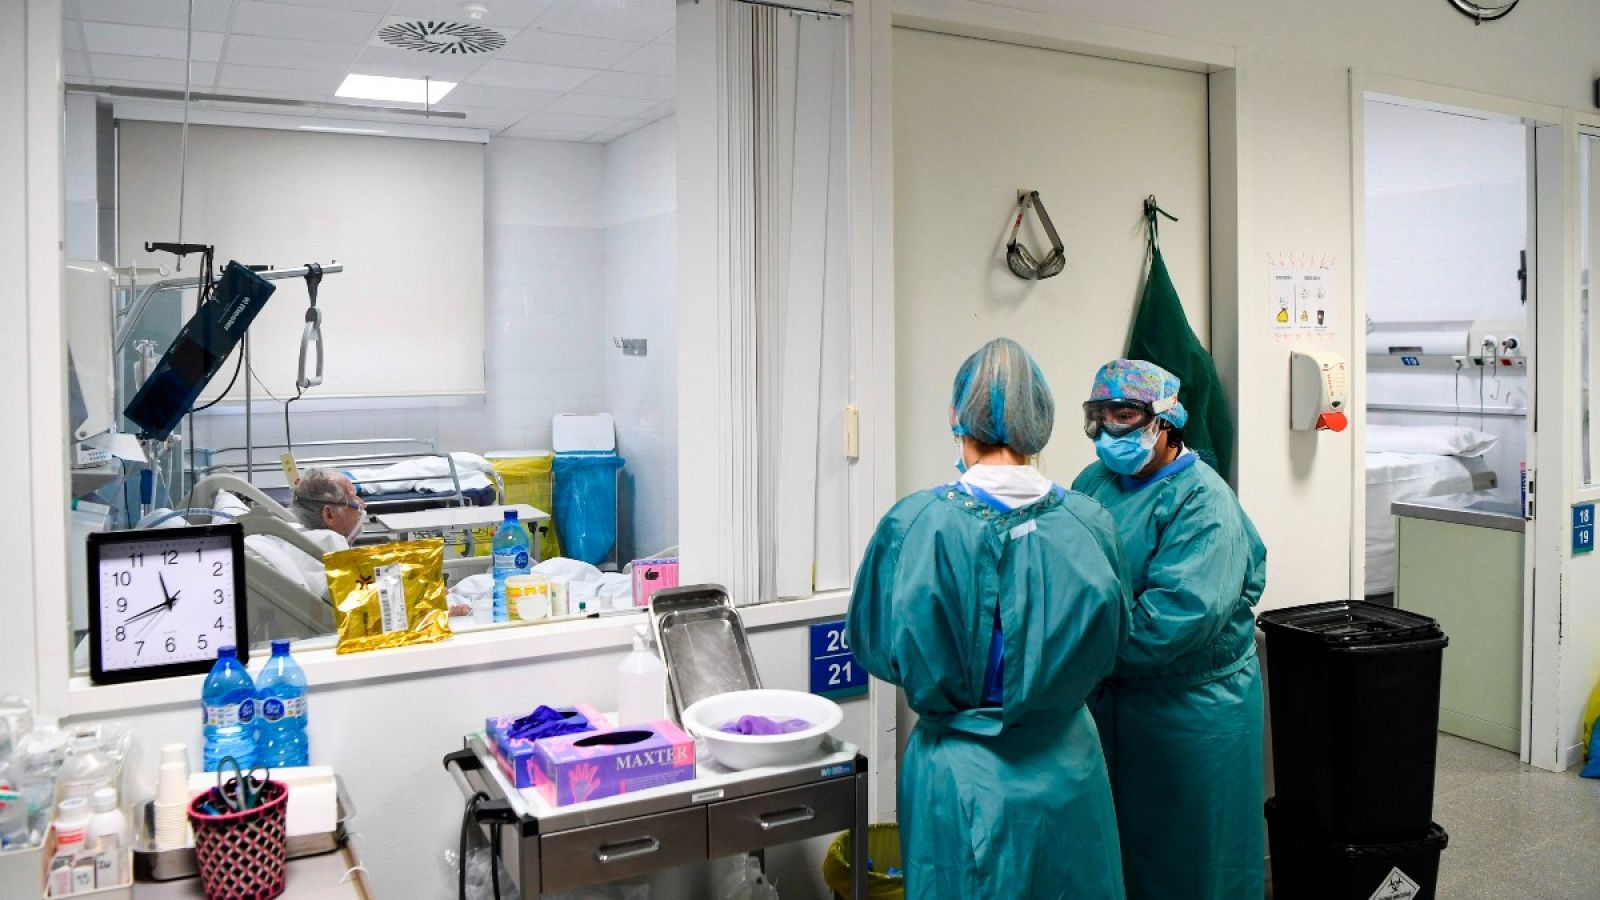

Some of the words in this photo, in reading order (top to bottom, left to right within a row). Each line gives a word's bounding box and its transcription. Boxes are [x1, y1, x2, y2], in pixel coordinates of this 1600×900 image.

[1579, 509, 1589, 523] 18
[1579, 530, 1589, 544] 19
[128, 552, 144, 568] 11
[160, 550, 178, 565] 12
[195, 548, 202, 563] 1
[212, 561, 223, 577] 2
[112, 571, 132, 587] 10
[213, 589, 224, 605] 3
[116, 597, 128, 613] 9
[213, 616, 224, 631] 4
[115, 626, 126, 642] 8
[197, 634, 208, 649] 5
[134, 641, 145, 656] 7
[164, 637, 176, 652] 6
[828, 661, 852, 685] 21
[615, 746, 689, 771] MAXTER
